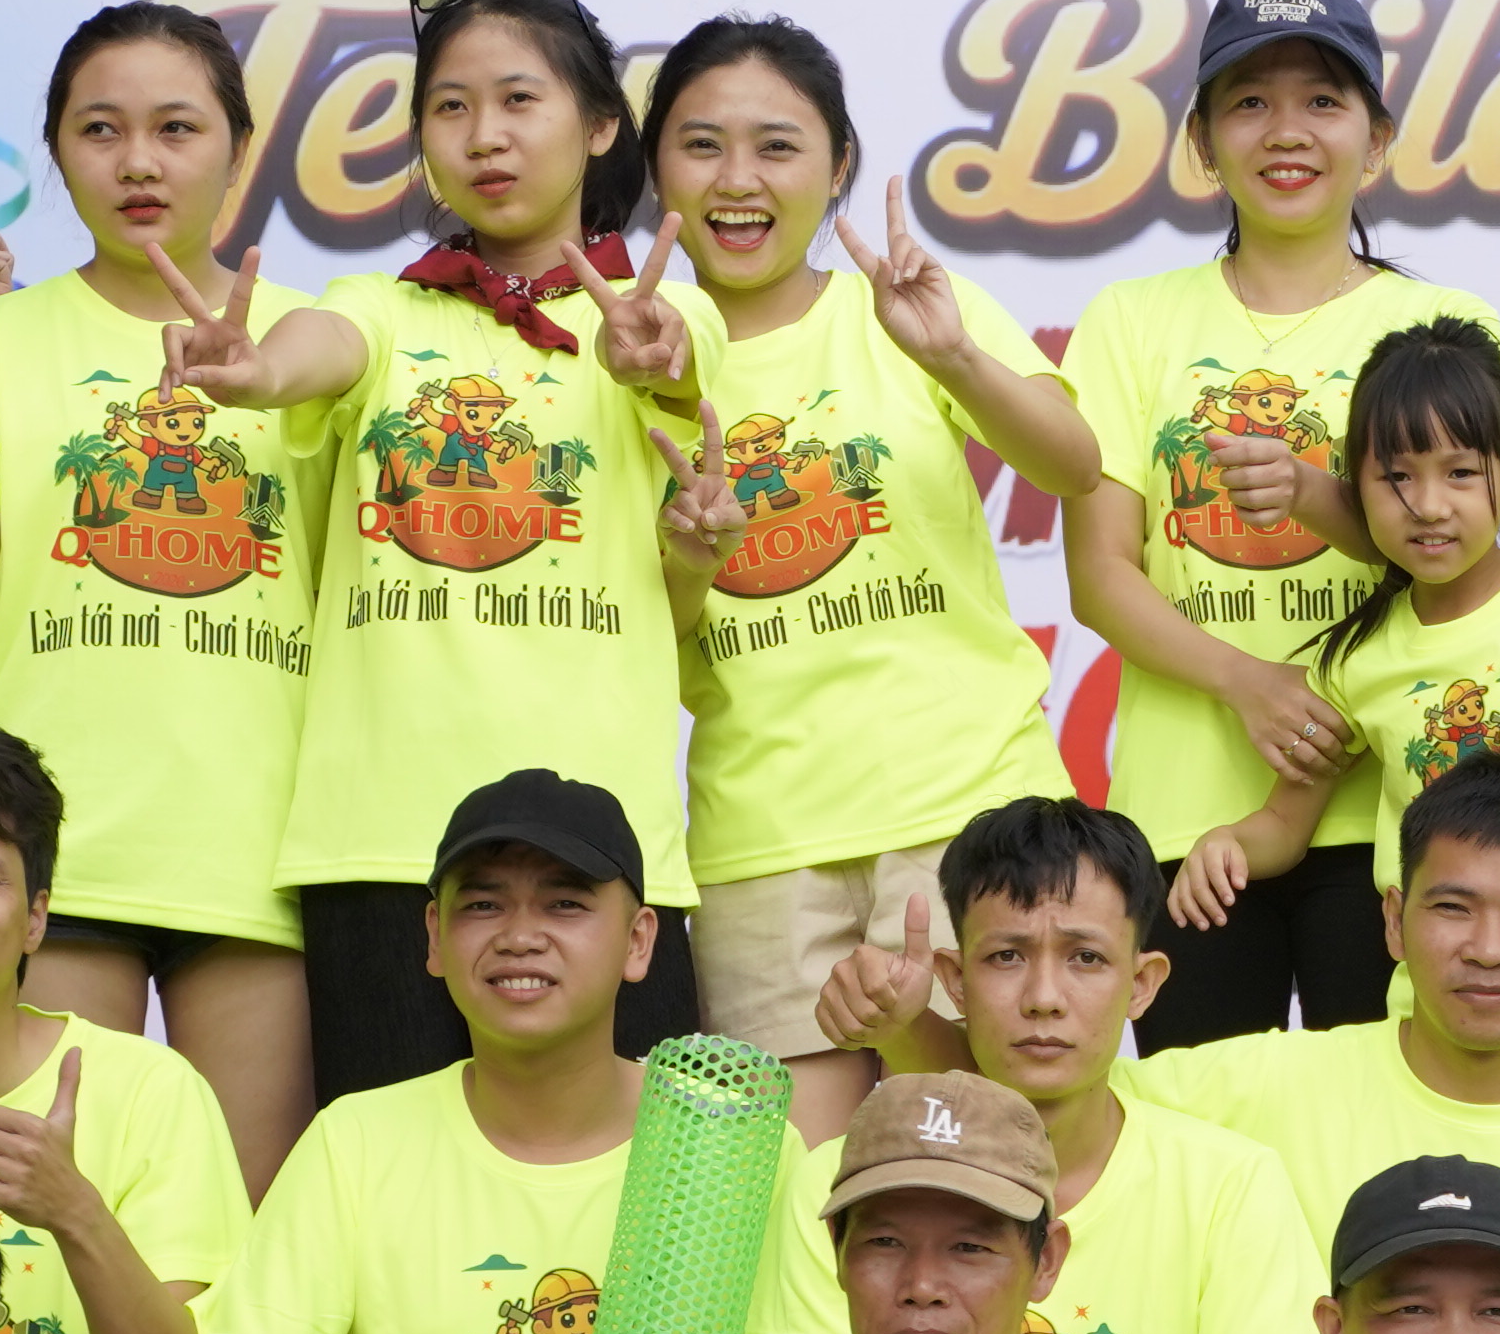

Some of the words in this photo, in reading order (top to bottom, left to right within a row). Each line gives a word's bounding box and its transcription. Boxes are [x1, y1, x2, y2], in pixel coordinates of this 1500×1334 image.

[1256, 13, 1280, 23] NEW
[1281, 14, 1308, 23] YORK
[358, 499, 585, 544] Q-HOME
[723, 500, 892, 576] HOME
[51, 523, 283, 579] Q-HOME
[377, 579, 411, 621] tới
[417, 577, 449, 622] nơi
[475, 583, 528, 627] Chơi
[538, 585, 572, 628] tới
[581, 586, 621, 635] bến
[708, 616, 743, 663] tới
[747, 606, 788, 652] nơi
[807, 584, 863, 635] Chơi
[865, 577, 896, 622] tới
[897, 567, 947, 617] bến
[1219, 579, 1256, 623] nơi
[1280, 578, 1336, 622] Chơi
[30, 609, 73, 654] Làm
[81, 603, 112, 647] tới
[122, 604, 160, 648] nơi
[185, 609, 237, 658] Chơi
[246, 617, 273, 664] tới
[275, 625, 312, 677] bến
[915, 1096, 962, 1145] LA
